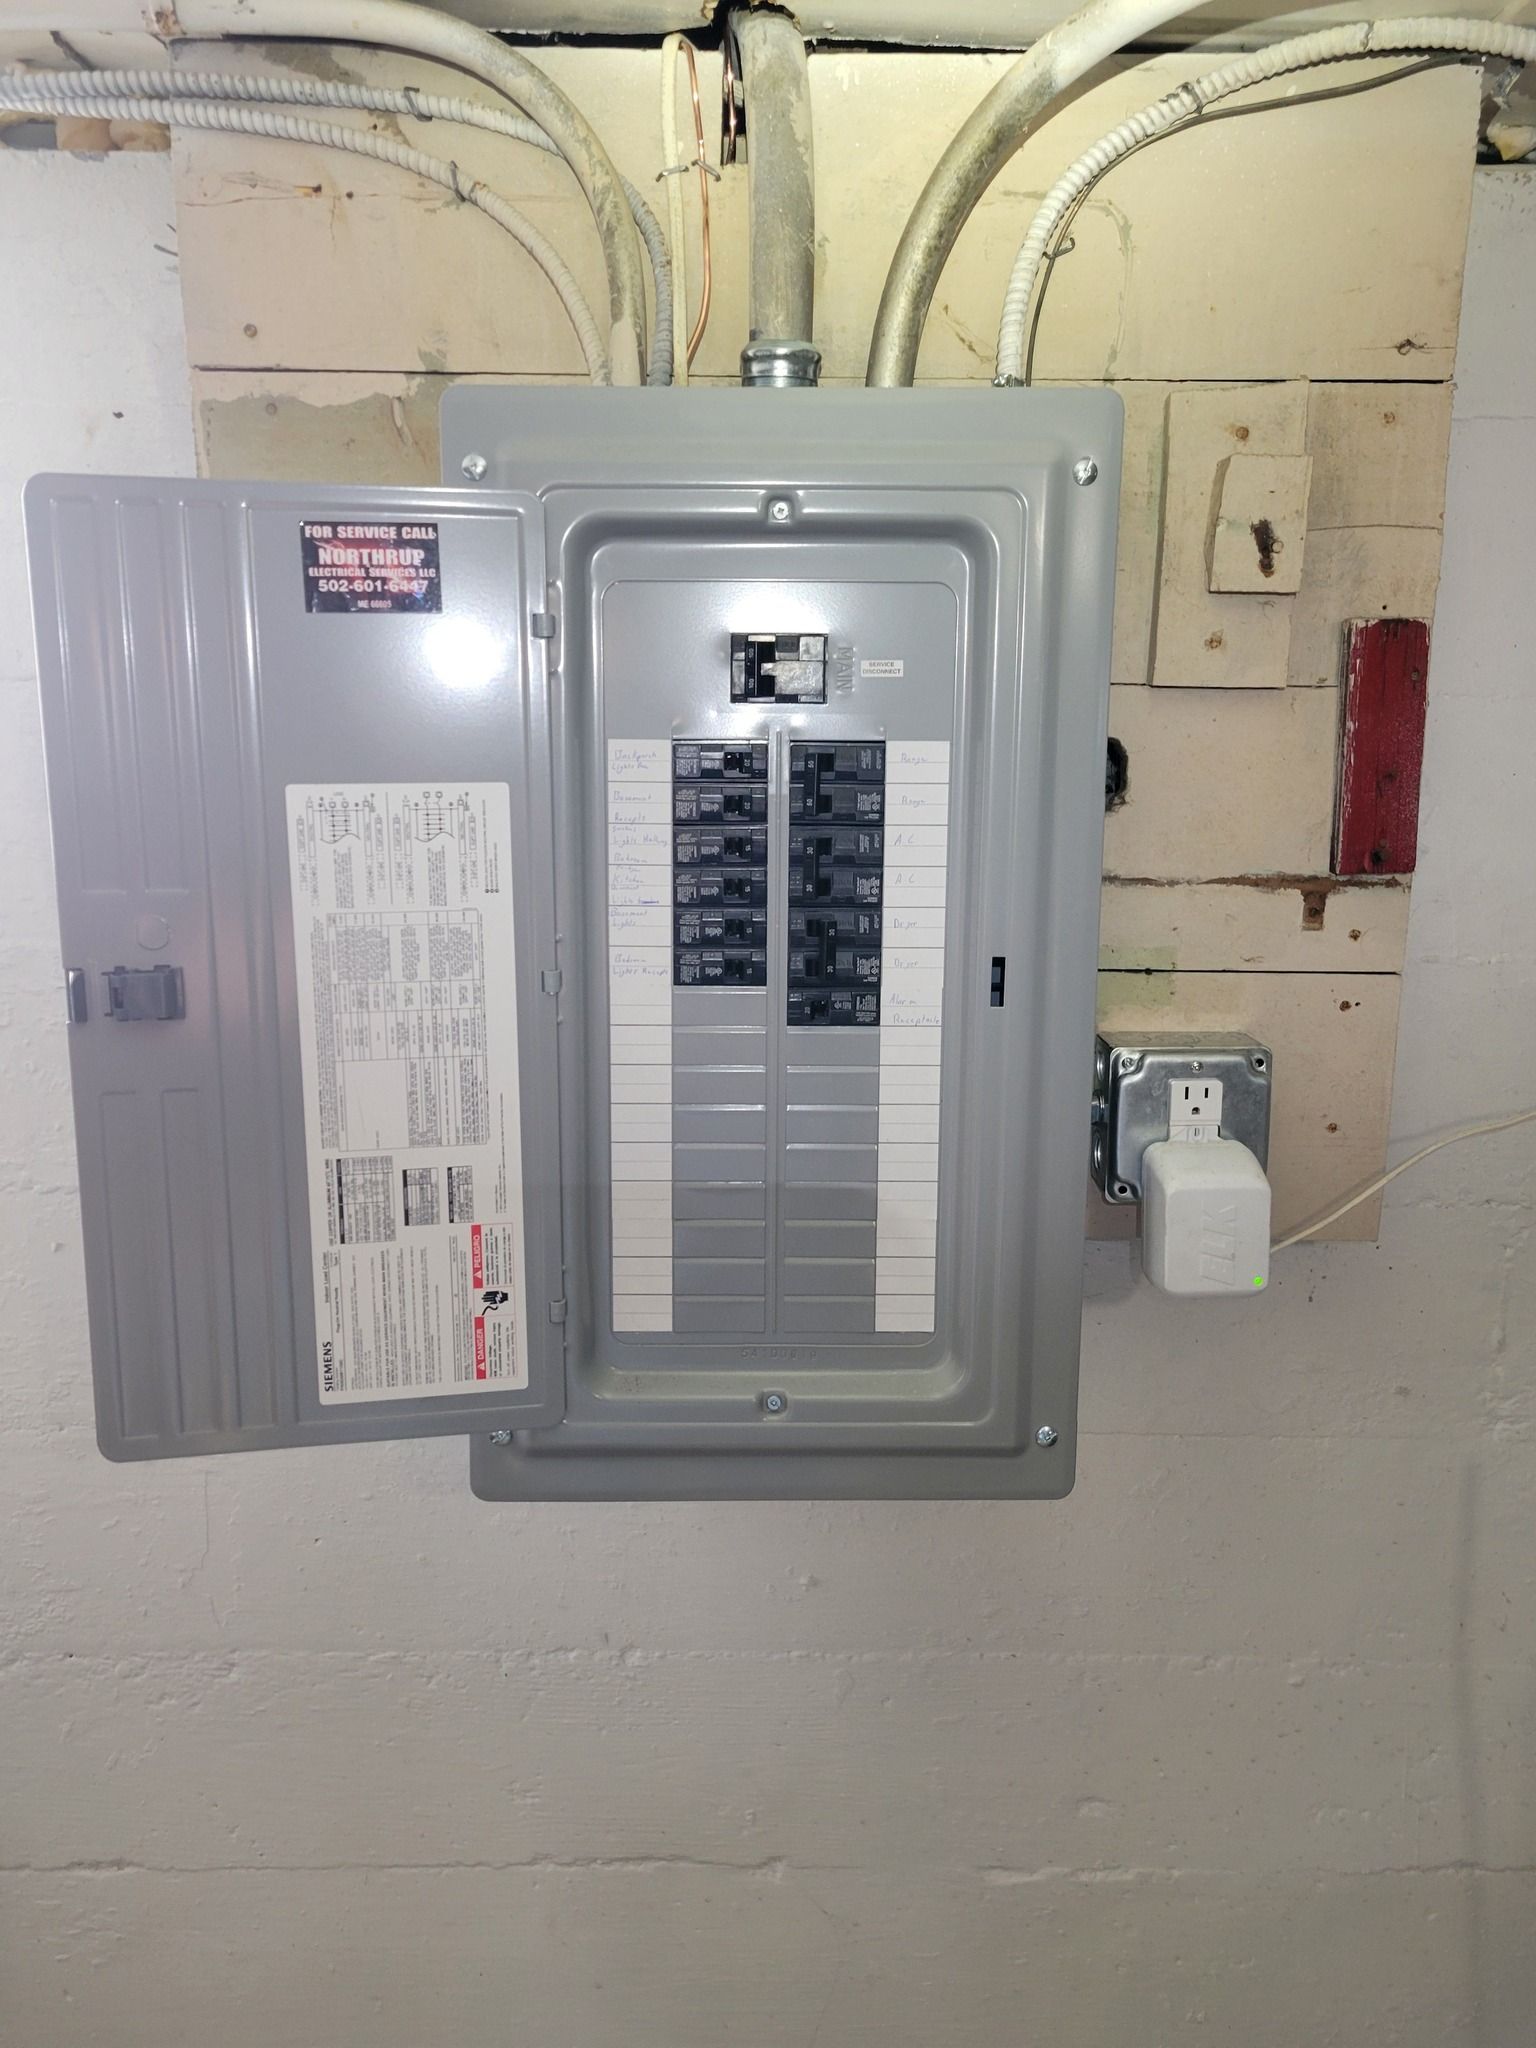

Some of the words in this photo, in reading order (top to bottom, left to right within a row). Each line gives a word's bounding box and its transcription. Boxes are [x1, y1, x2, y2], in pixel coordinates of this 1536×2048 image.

[305, 525, 332, 538] FOR
[337, 526, 397, 539] SERVICE
[402, 526, 436, 539] CALL
[308, 567, 366, 577] ELECTRICAL
[369, 567, 416, 577] SERVICES
[419, 567, 436, 577] LLC
[318, 547, 425, 566] NORTHRUP
[836, 646, 855, 693] MAIN
[473, 1234, 481, 1268] PELIGRO
[1200, 1204, 1238, 1286] ELK
[476, 1328, 484, 1360] DANGER
[322, 1341, 334, 1392] SIEMENS
